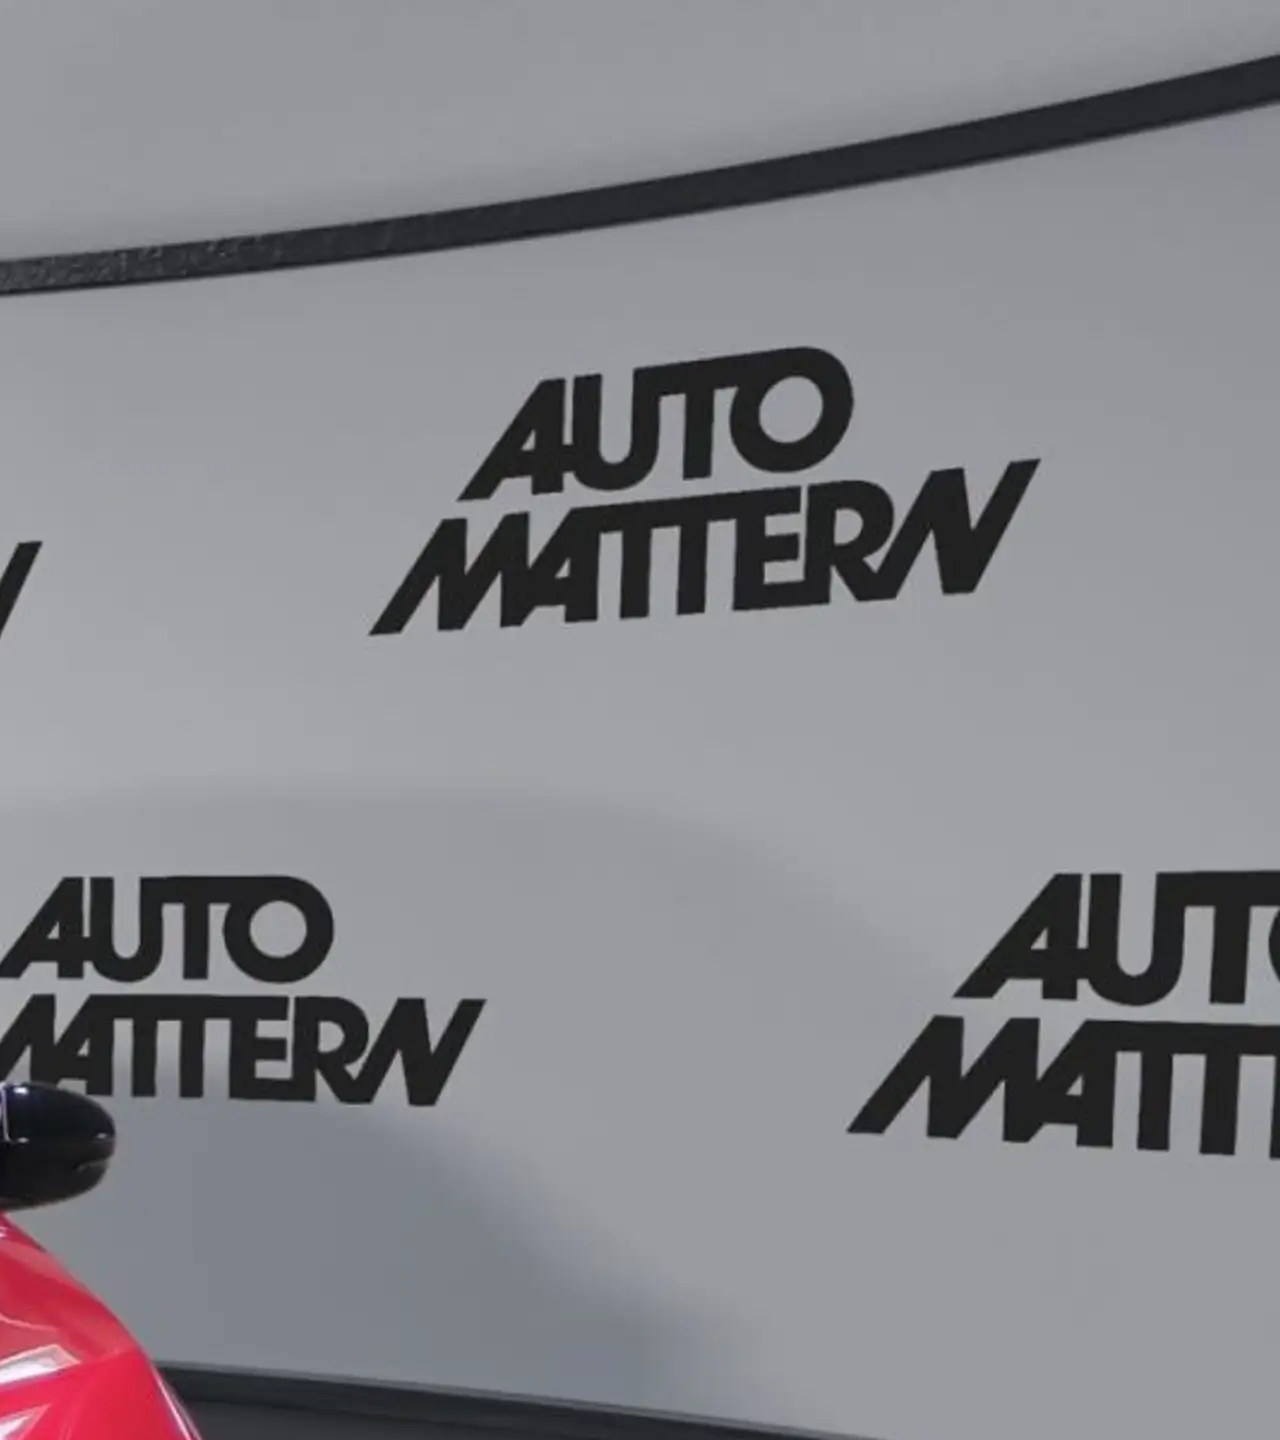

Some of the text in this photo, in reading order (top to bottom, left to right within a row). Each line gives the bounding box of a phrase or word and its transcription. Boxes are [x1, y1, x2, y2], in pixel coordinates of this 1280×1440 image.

[458, 347, 854, 501] AUTO
[370, 459, 1040, 635] MATTERN
[953, 870, 1280, 1006] AUT
[847, 1015, 1280, 1160] MATT
